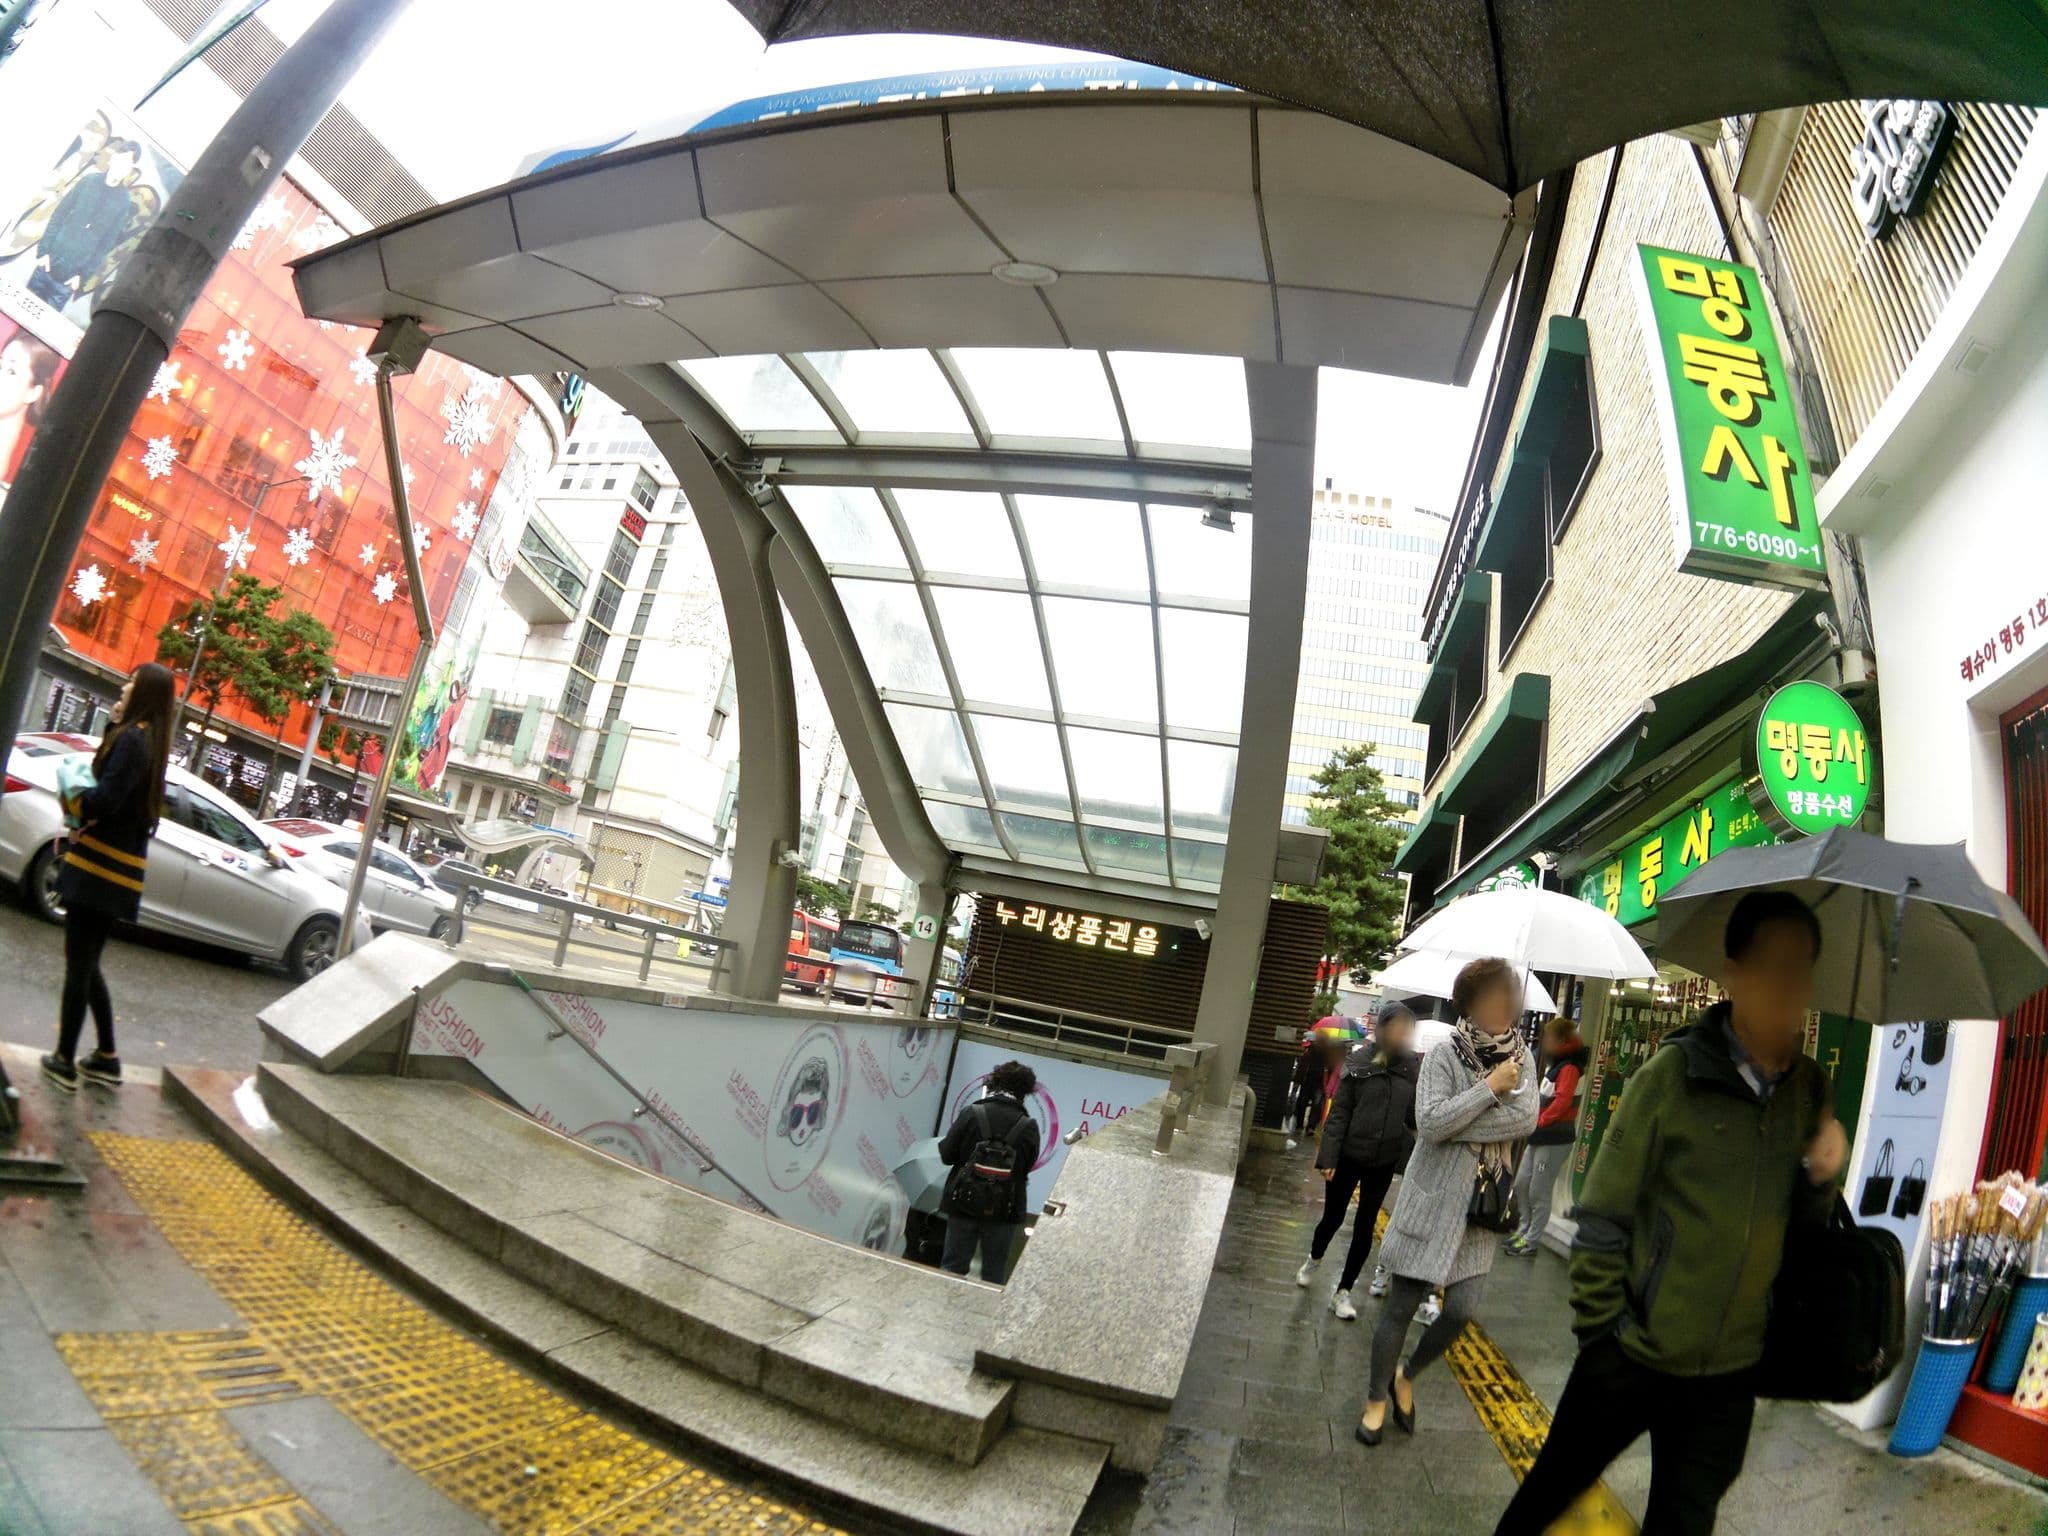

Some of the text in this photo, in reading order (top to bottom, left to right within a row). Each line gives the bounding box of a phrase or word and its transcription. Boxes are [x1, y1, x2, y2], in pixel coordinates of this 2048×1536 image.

[978, 67, 1057, 84] SHOPPING
[1060, 65, 1119, 80] CENTER
[1892, 143, 1919, 197] SINCE
[1657, 255, 1796, 528] 명동사
[1350, 513, 1393, 529] HOTEL
[1457, 482, 1486, 577] COFFEE
[1695, 521, 1822, 566] 776-6090~1
[1960, 592, 2048, 683] 레슈아 명동 1호
[1766, 719, 1866, 786] 명동사
[1786, 790, 1853, 819] 명품수선
[918, 920, 932, 934] 14
[995, 900, 1161, 957] 누리상품권을
[423, 994, 486, 1058] USHION
[1081, 1098, 1134, 1121] LALA
